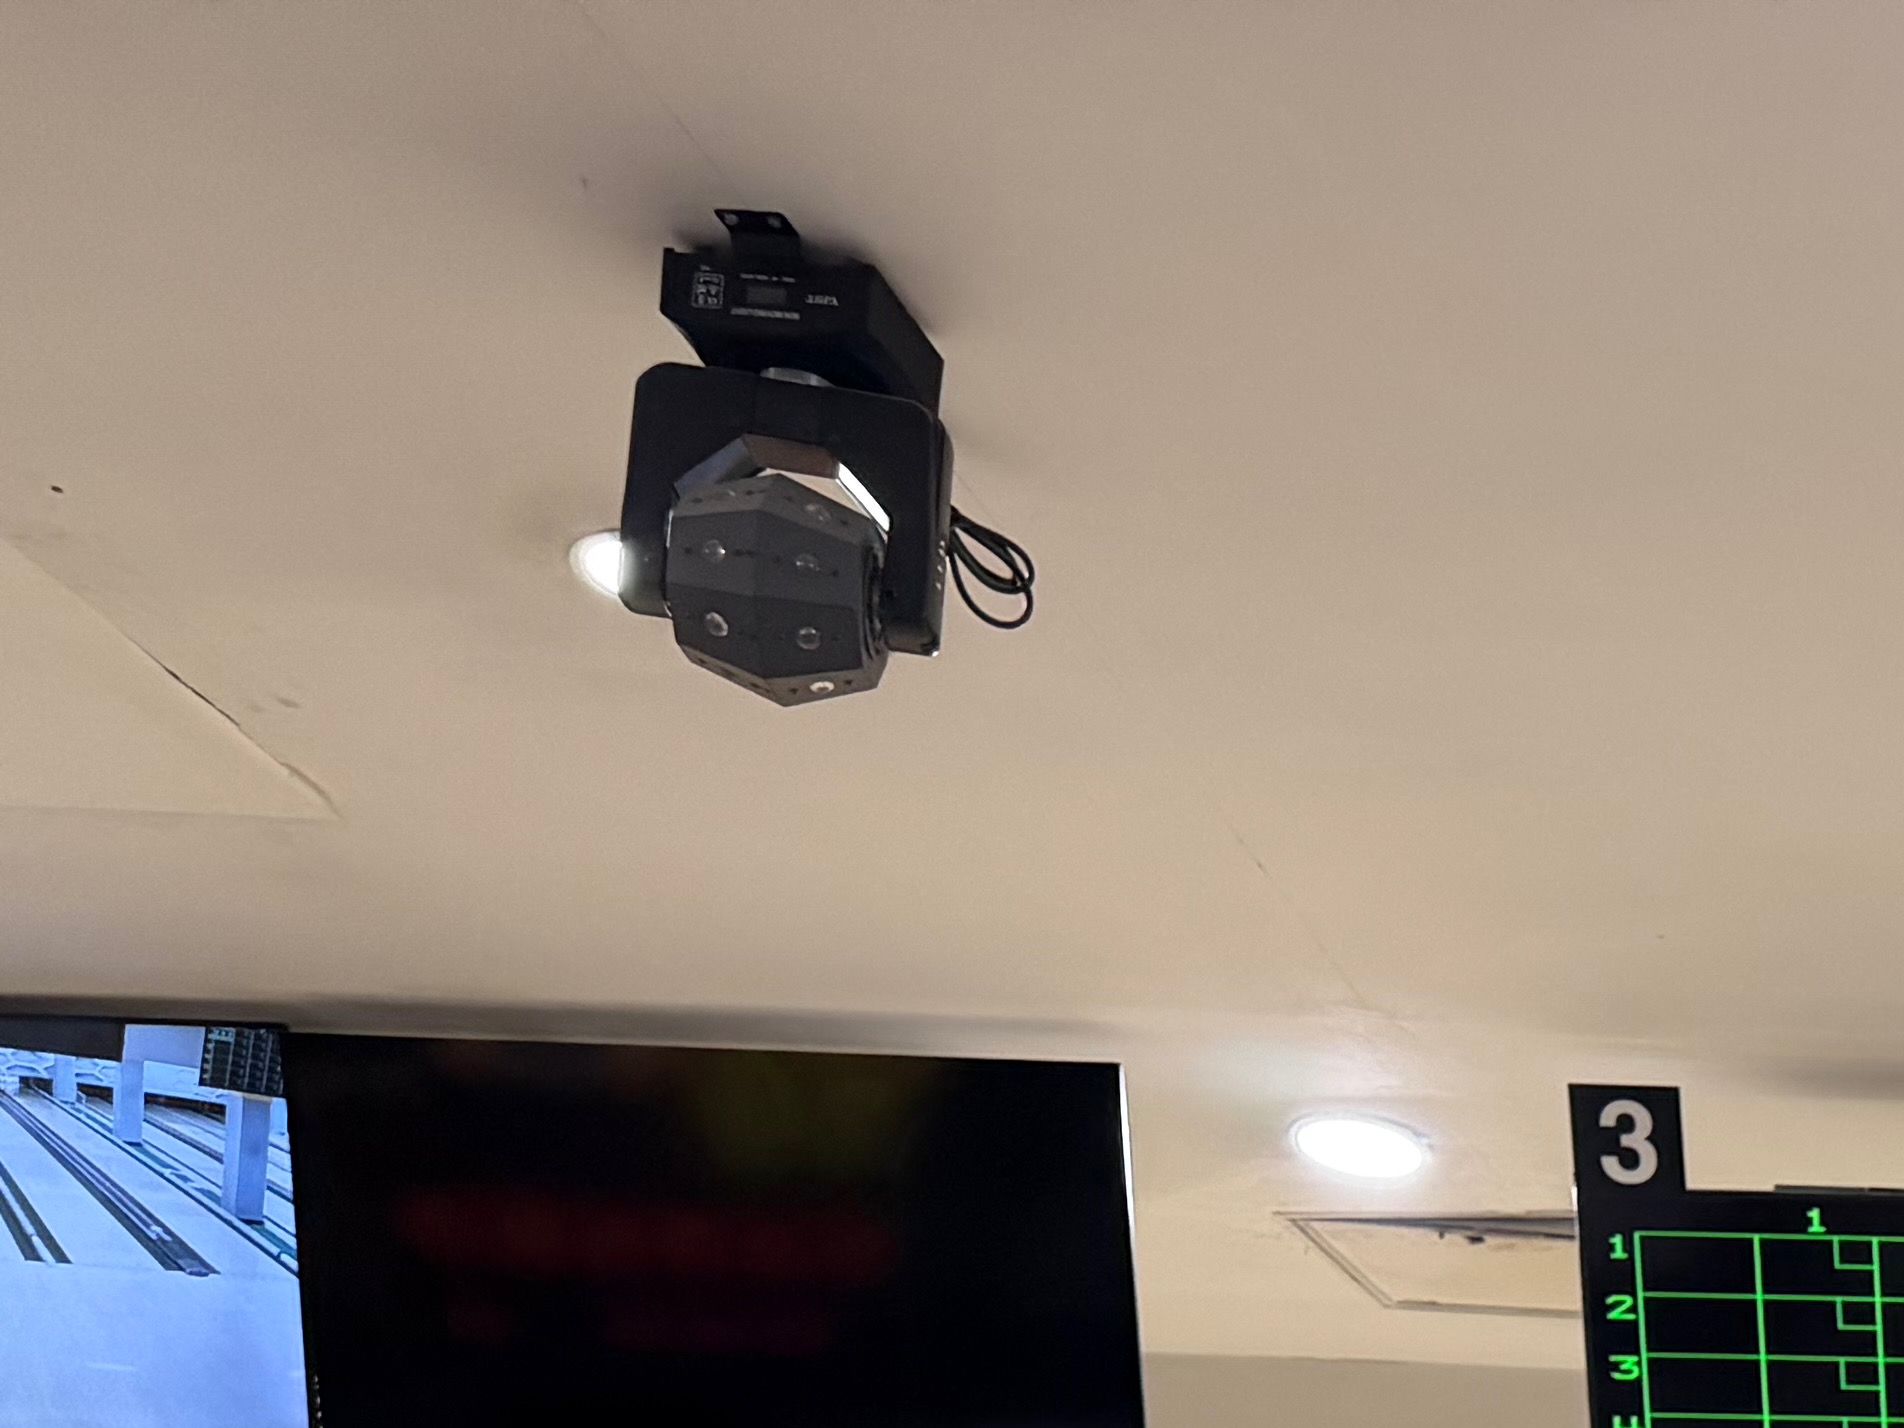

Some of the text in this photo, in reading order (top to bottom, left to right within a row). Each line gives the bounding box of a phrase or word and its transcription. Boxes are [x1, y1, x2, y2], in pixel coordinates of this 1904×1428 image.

[1599, 1099, 1659, 1185] 3
[1807, 1208, 1826, 1234] 1
[1609, 1234, 1629, 1261] 1
[1606, 1294, 1637, 1321] 2
[1609, 1354, 1641, 1381] 3
